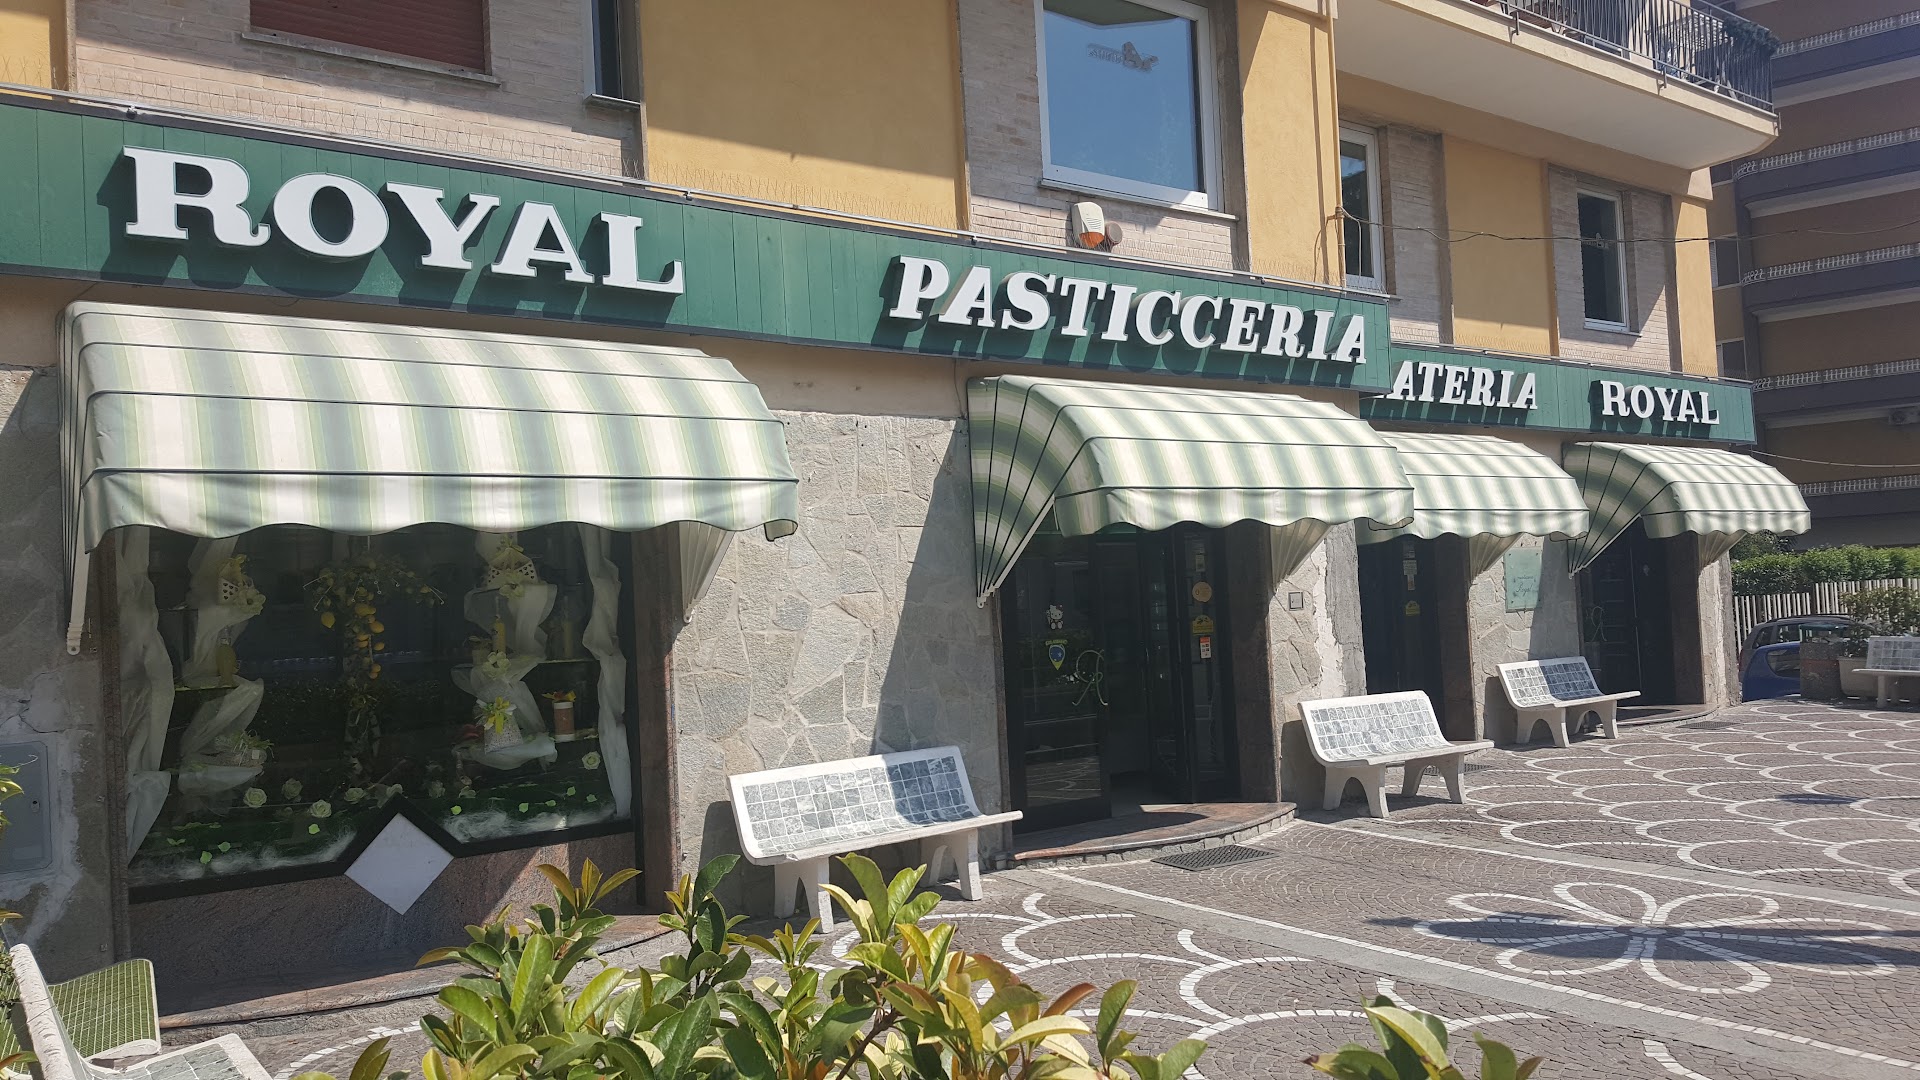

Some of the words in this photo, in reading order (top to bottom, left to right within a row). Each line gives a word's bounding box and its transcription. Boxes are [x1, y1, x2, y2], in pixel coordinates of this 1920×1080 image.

[123, 146, 684, 294] ROYAL
[889, 255, 1366, 364] PASTICCERIA
[1375, 360, 1538, 410] ATERIA
[1601, 380, 1719, 425] ROYAL
